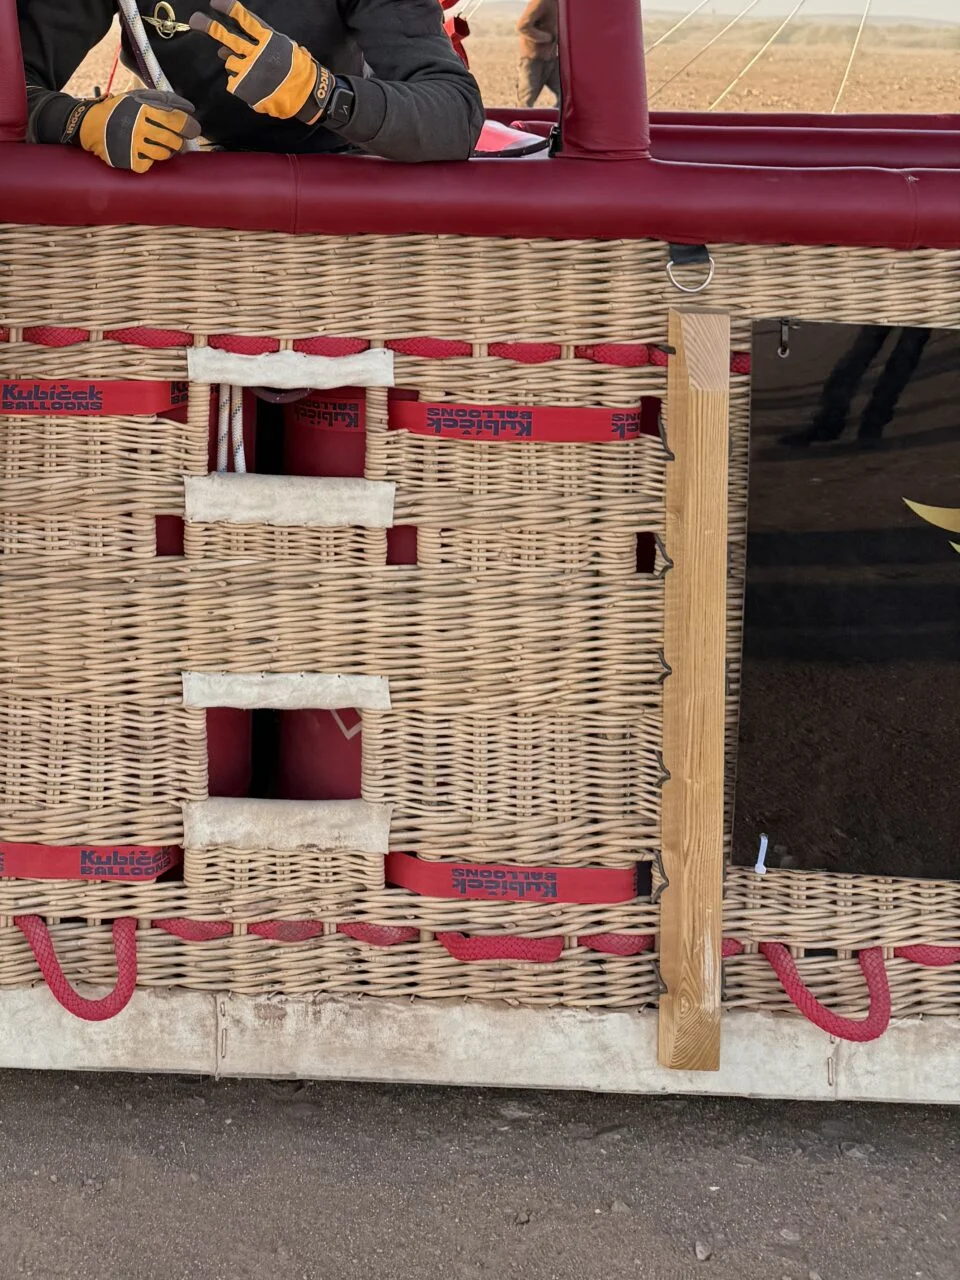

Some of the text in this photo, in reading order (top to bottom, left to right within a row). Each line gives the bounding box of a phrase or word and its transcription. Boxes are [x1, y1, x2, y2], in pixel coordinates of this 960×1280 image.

[2, 400, 103, 411] BALLOONS
[427, 407, 533, 420] BALLOONS
[452, 868, 557, 881] BALLOONS
